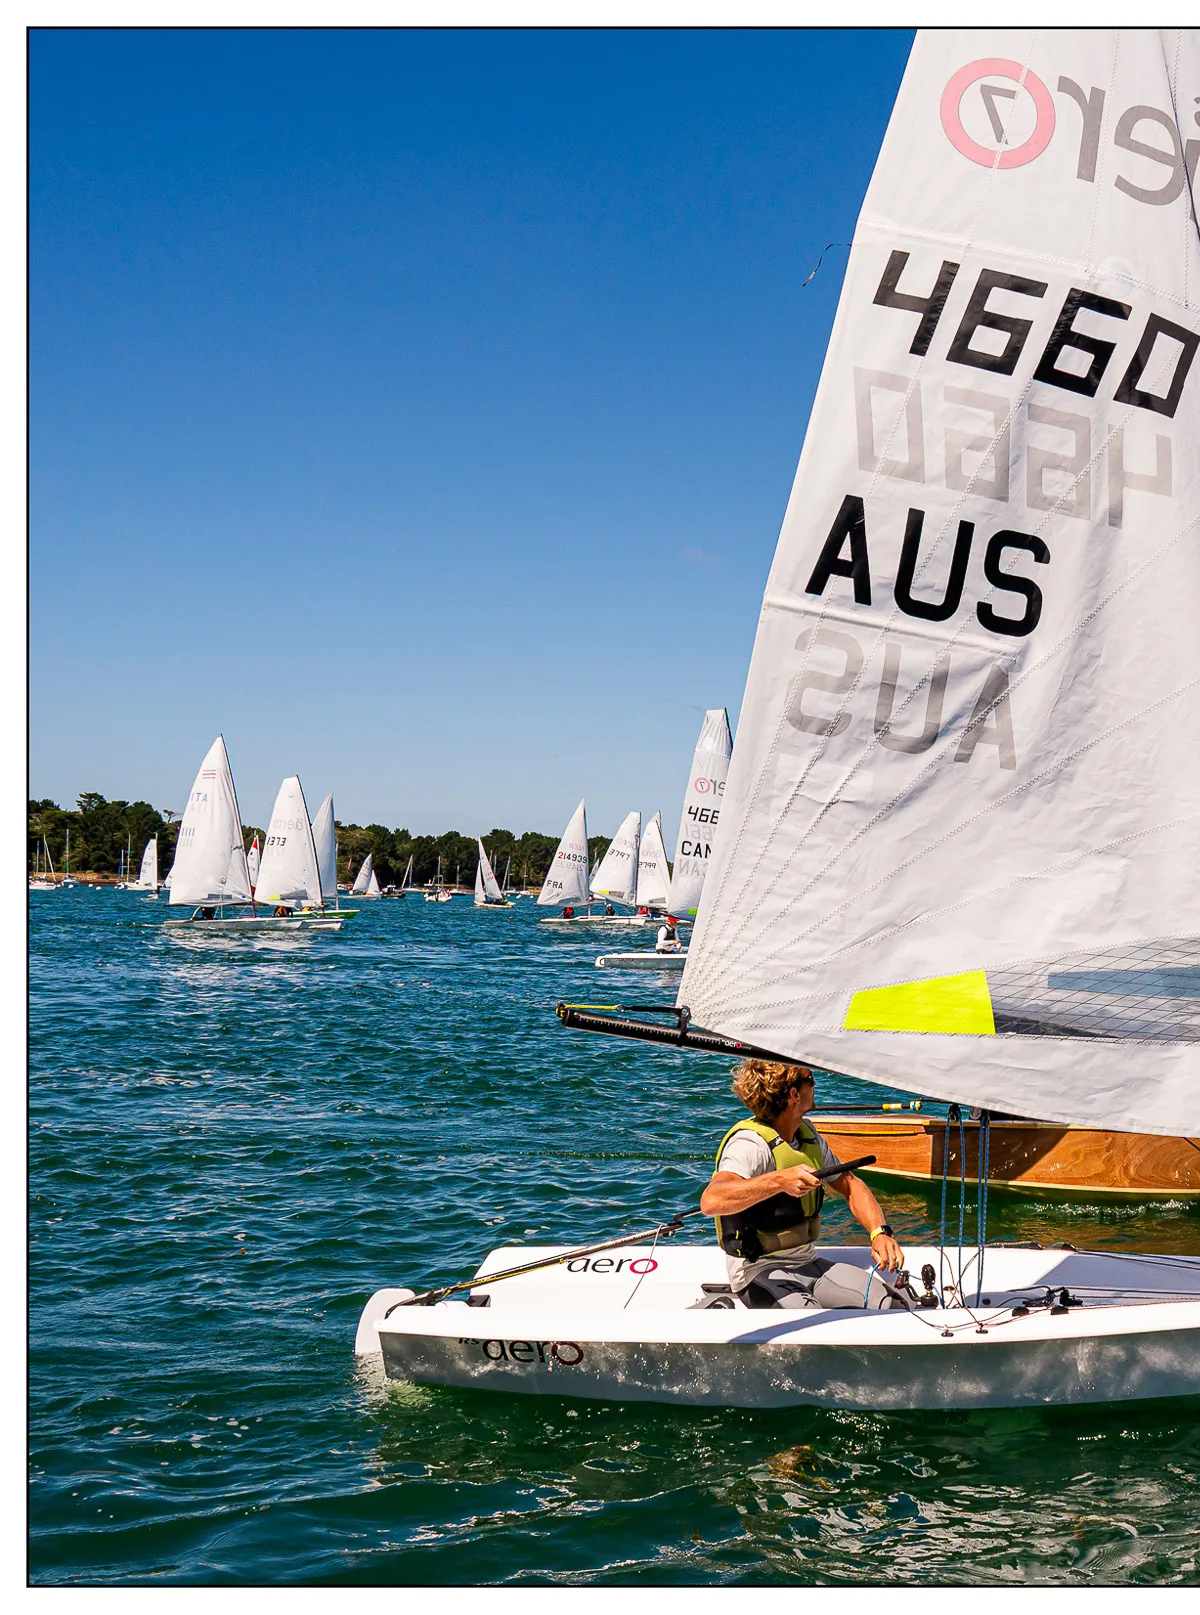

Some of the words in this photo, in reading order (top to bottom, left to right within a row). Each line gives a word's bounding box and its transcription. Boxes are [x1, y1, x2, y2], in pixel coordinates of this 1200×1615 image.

[805, 494, 1051, 637] AUS
[191, 791, 208, 802] ITA
[688, 805, 720, 825] 466
[266, 836, 287, 847] 1373
[558, 851, 588, 864] 214939
[546, 879, 563, 890] FRA
[567, 1257, 658, 1275] aero
[482, 1338, 584, 1367] aero
